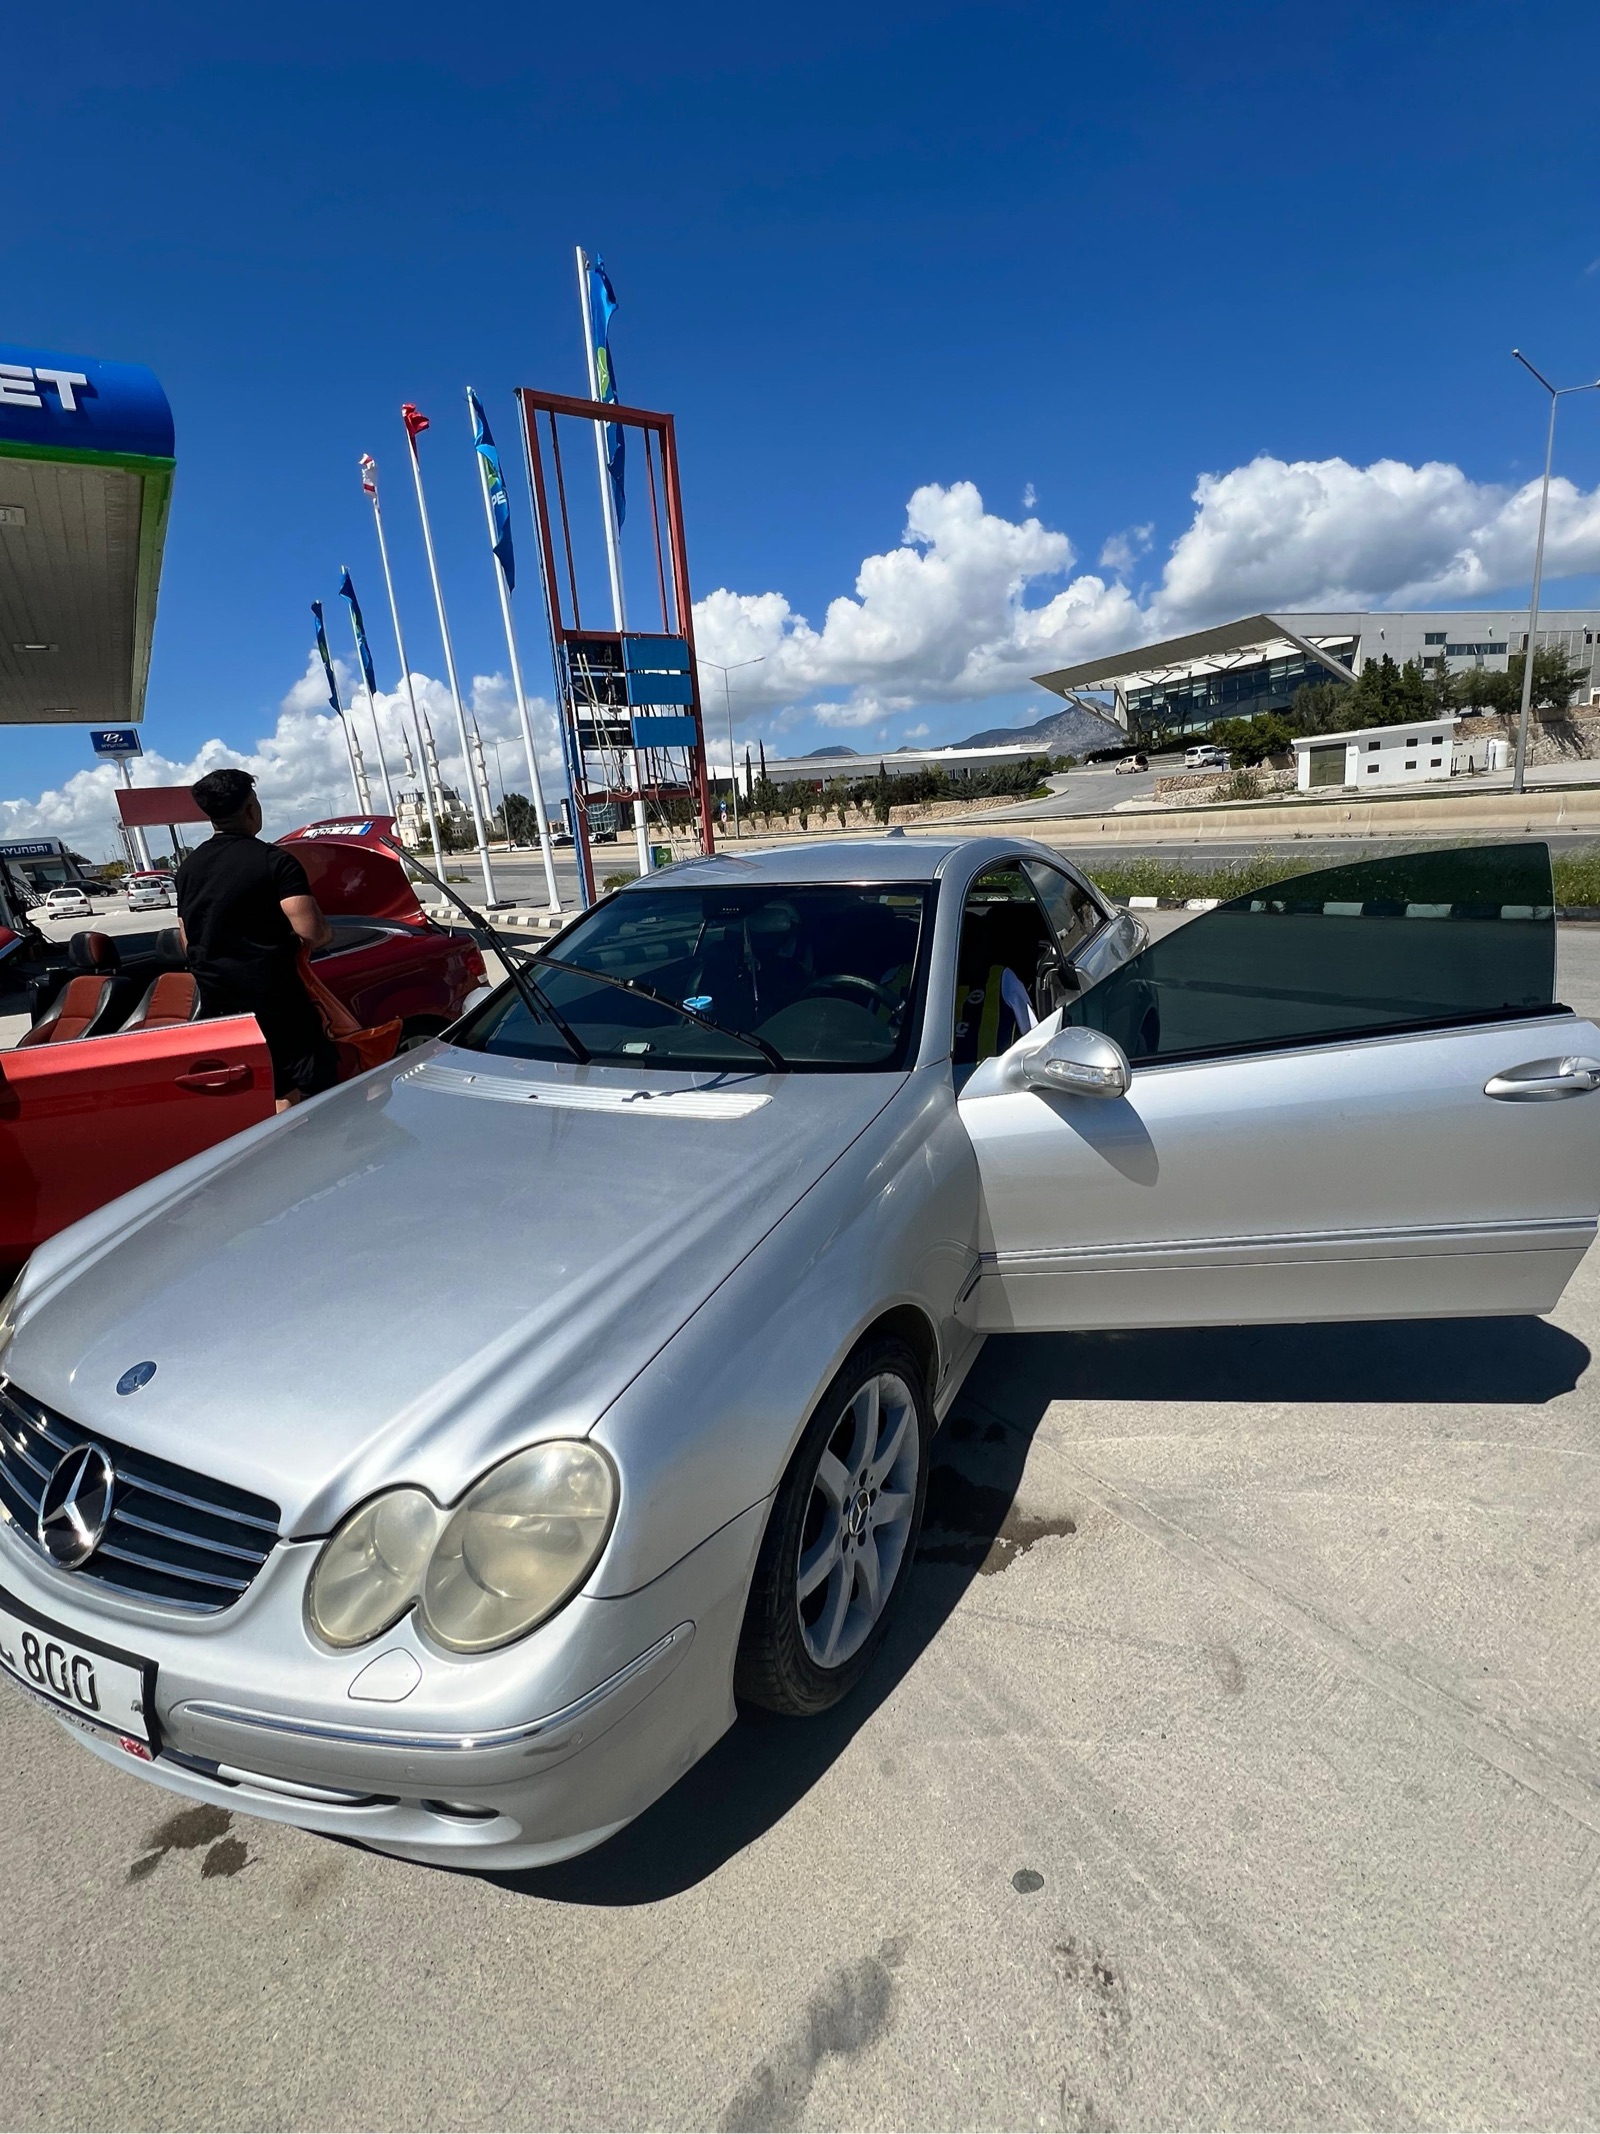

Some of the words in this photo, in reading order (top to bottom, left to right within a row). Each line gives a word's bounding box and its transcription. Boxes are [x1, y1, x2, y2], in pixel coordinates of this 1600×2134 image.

[0, 363, 88, 411] ET
[0, 845, 48, 855] HYUNDAI
[21, 1631, 101, 1712] 800
